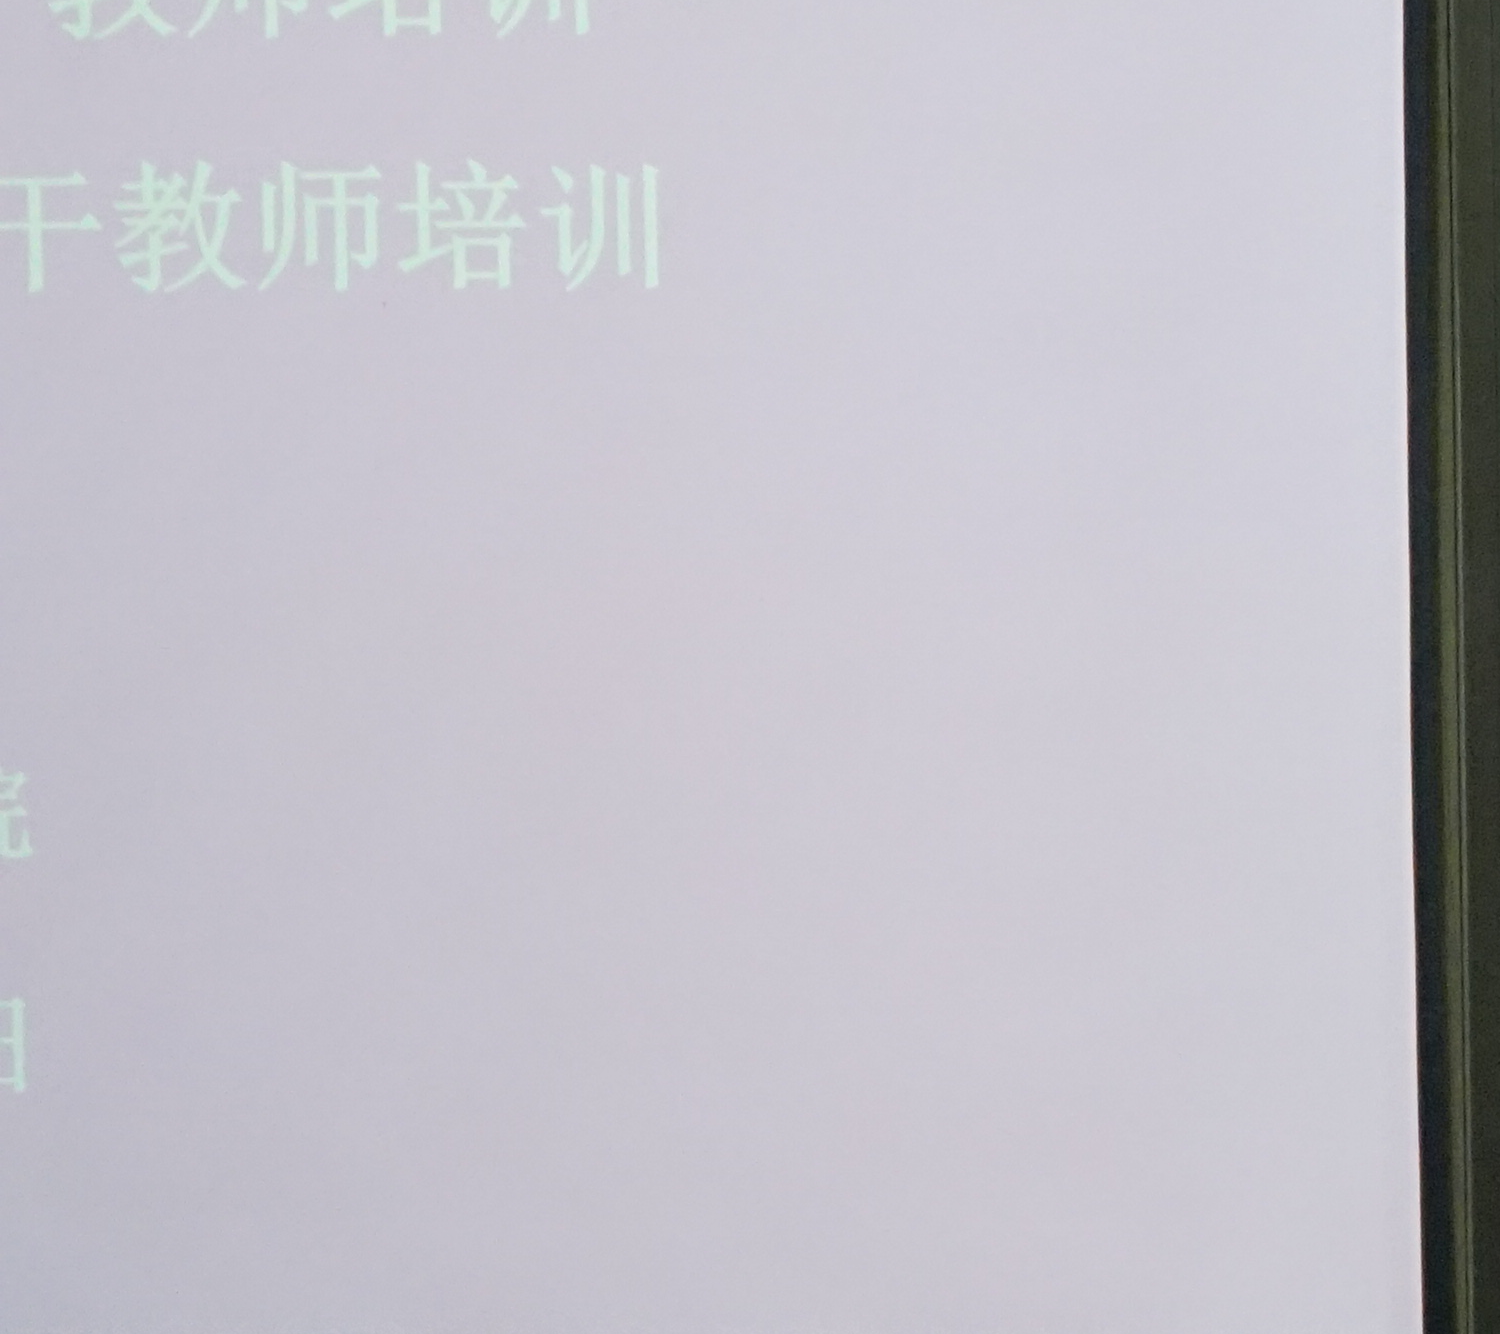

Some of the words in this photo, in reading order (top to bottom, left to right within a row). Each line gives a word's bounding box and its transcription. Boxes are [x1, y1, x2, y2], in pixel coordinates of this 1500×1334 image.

[0, 158, 660, 293] 干教师培训
